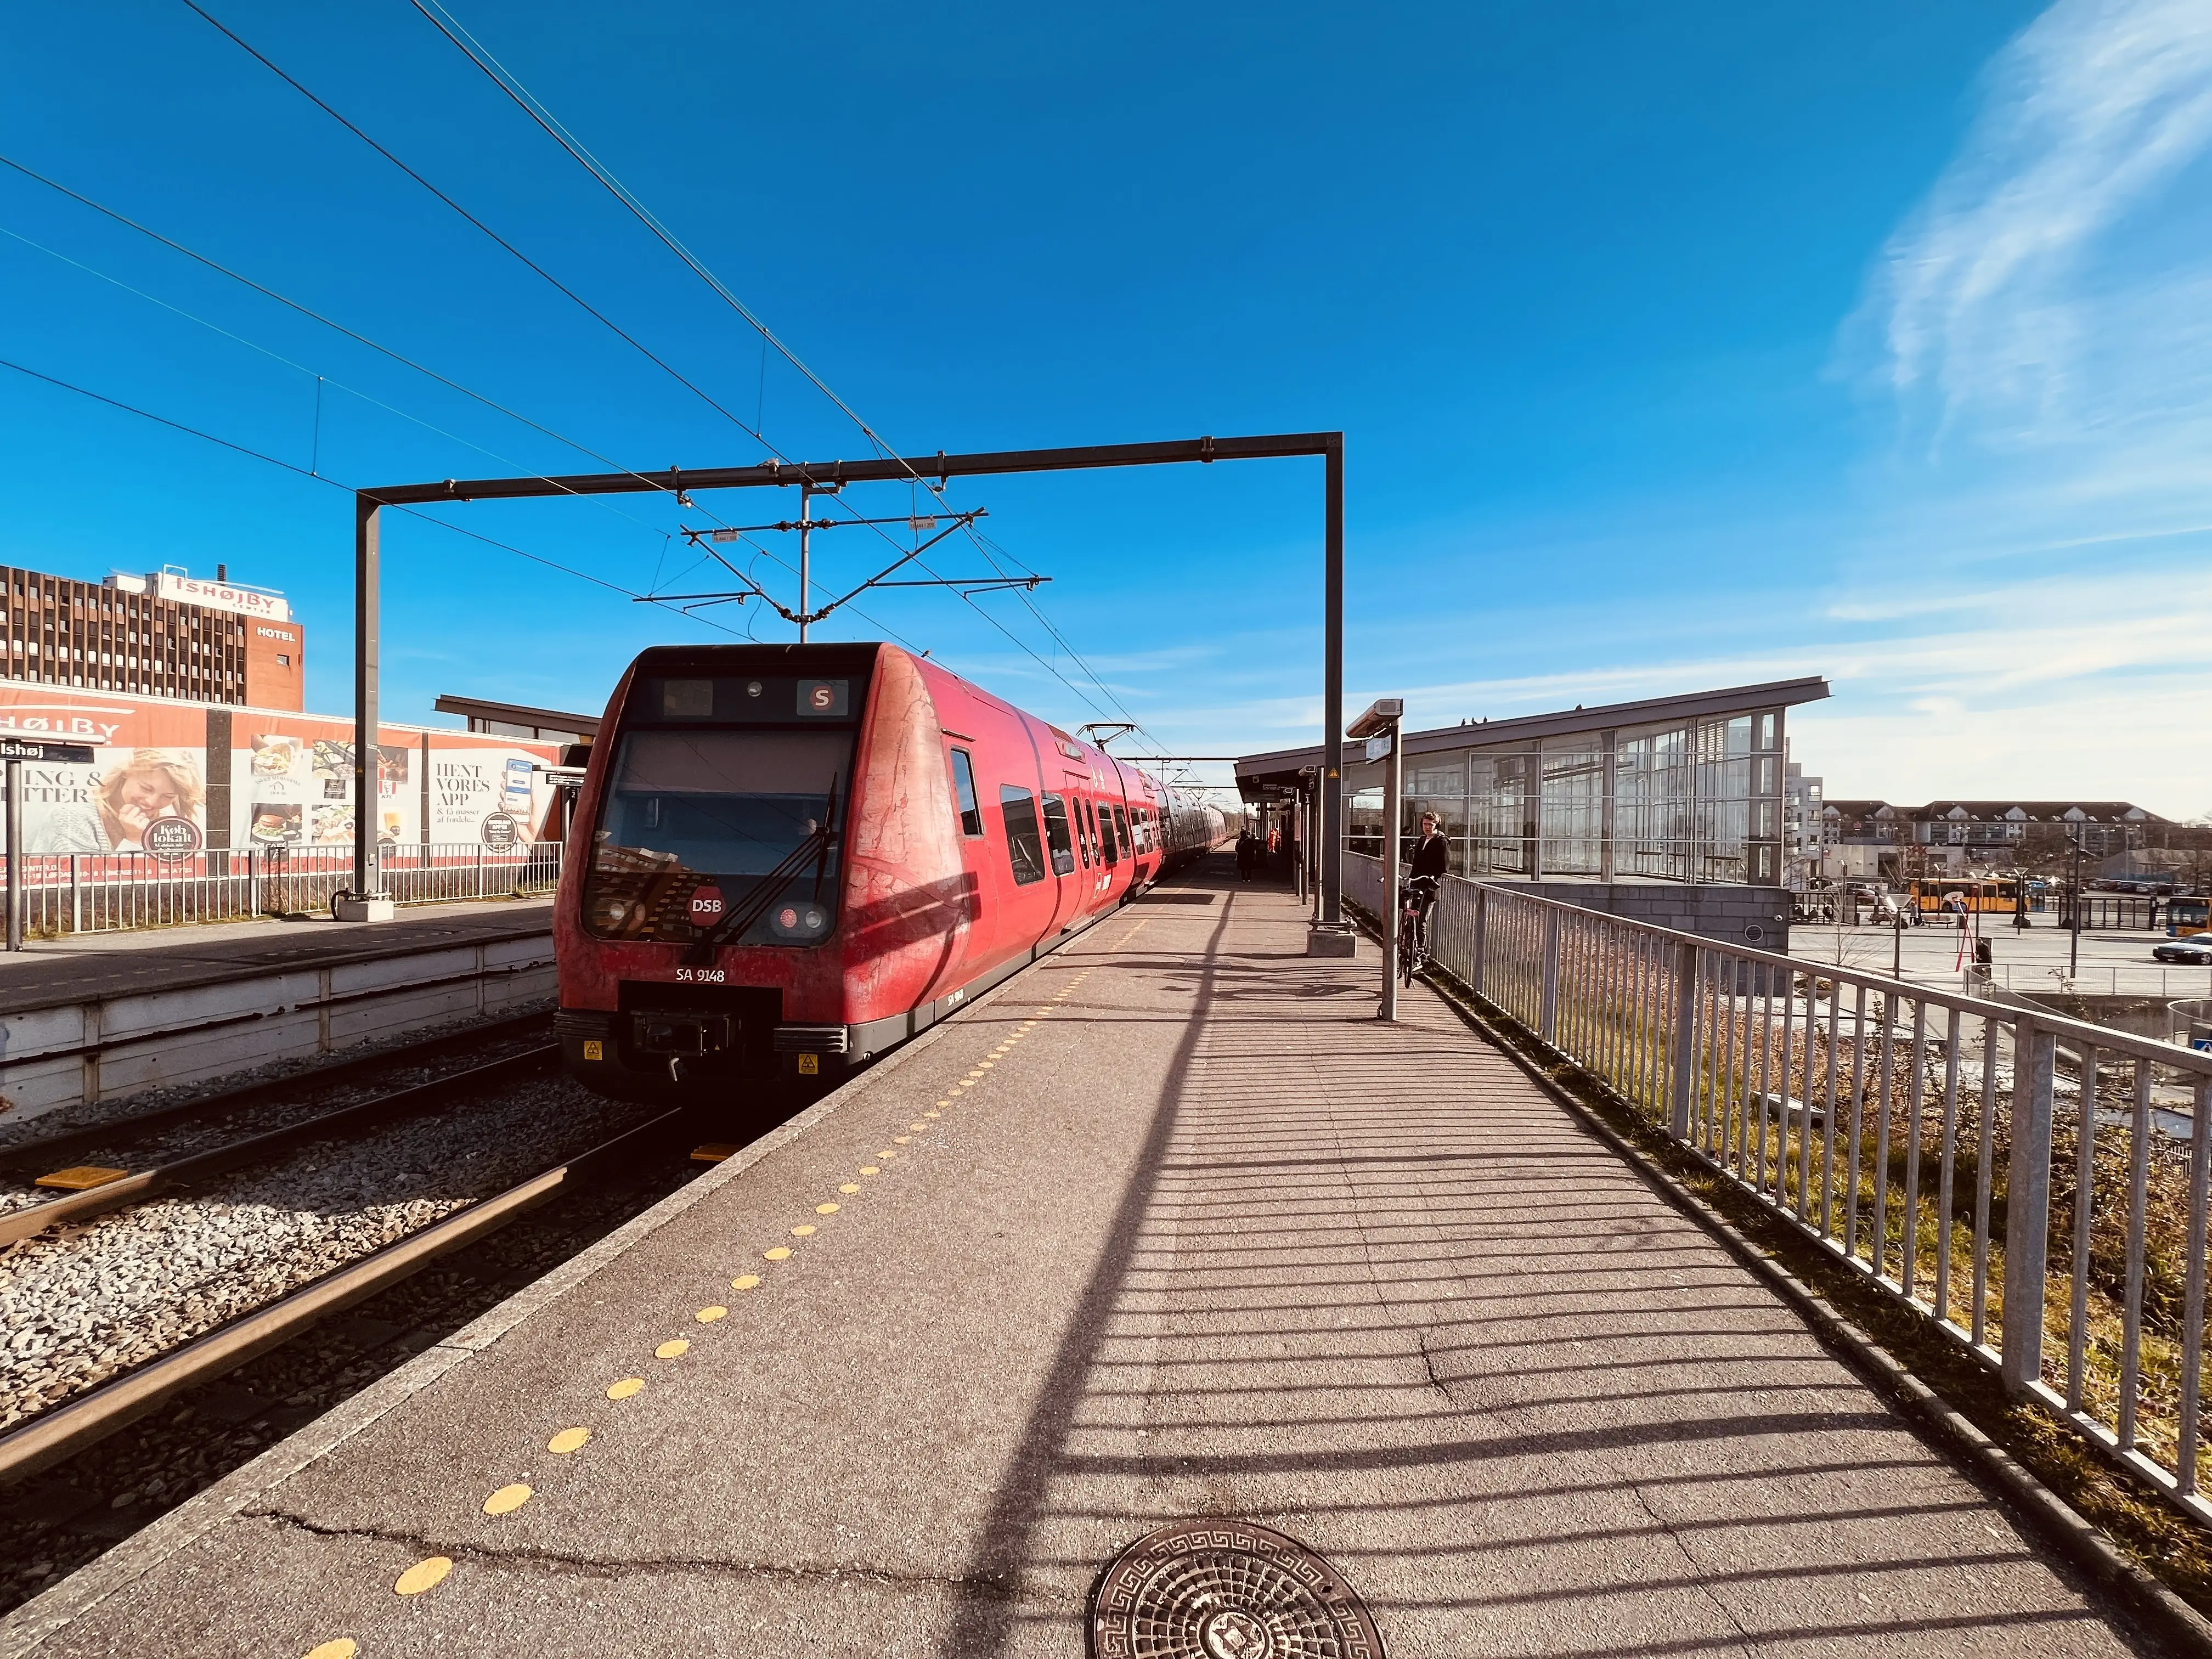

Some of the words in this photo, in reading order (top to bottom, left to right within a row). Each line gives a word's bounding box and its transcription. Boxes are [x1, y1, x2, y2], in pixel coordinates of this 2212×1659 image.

[232, 603, 271, 614] CENTER
[257, 626, 296, 642] HOTEL
[815, 690, 830, 707] S
[1, 742, 44, 759] Ishøj
[436, 763, 482, 778] HENT
[86, 771, 107, 787] &
[436, 778, 490, 792] VORES
[437, 793, 469, 806] APP
[153, 832, 193, 843] lokalt
[692, 899, 722, 912] DSB
[676, 968, 693, 981] SA
[697, 969, 725, 983] 9148
